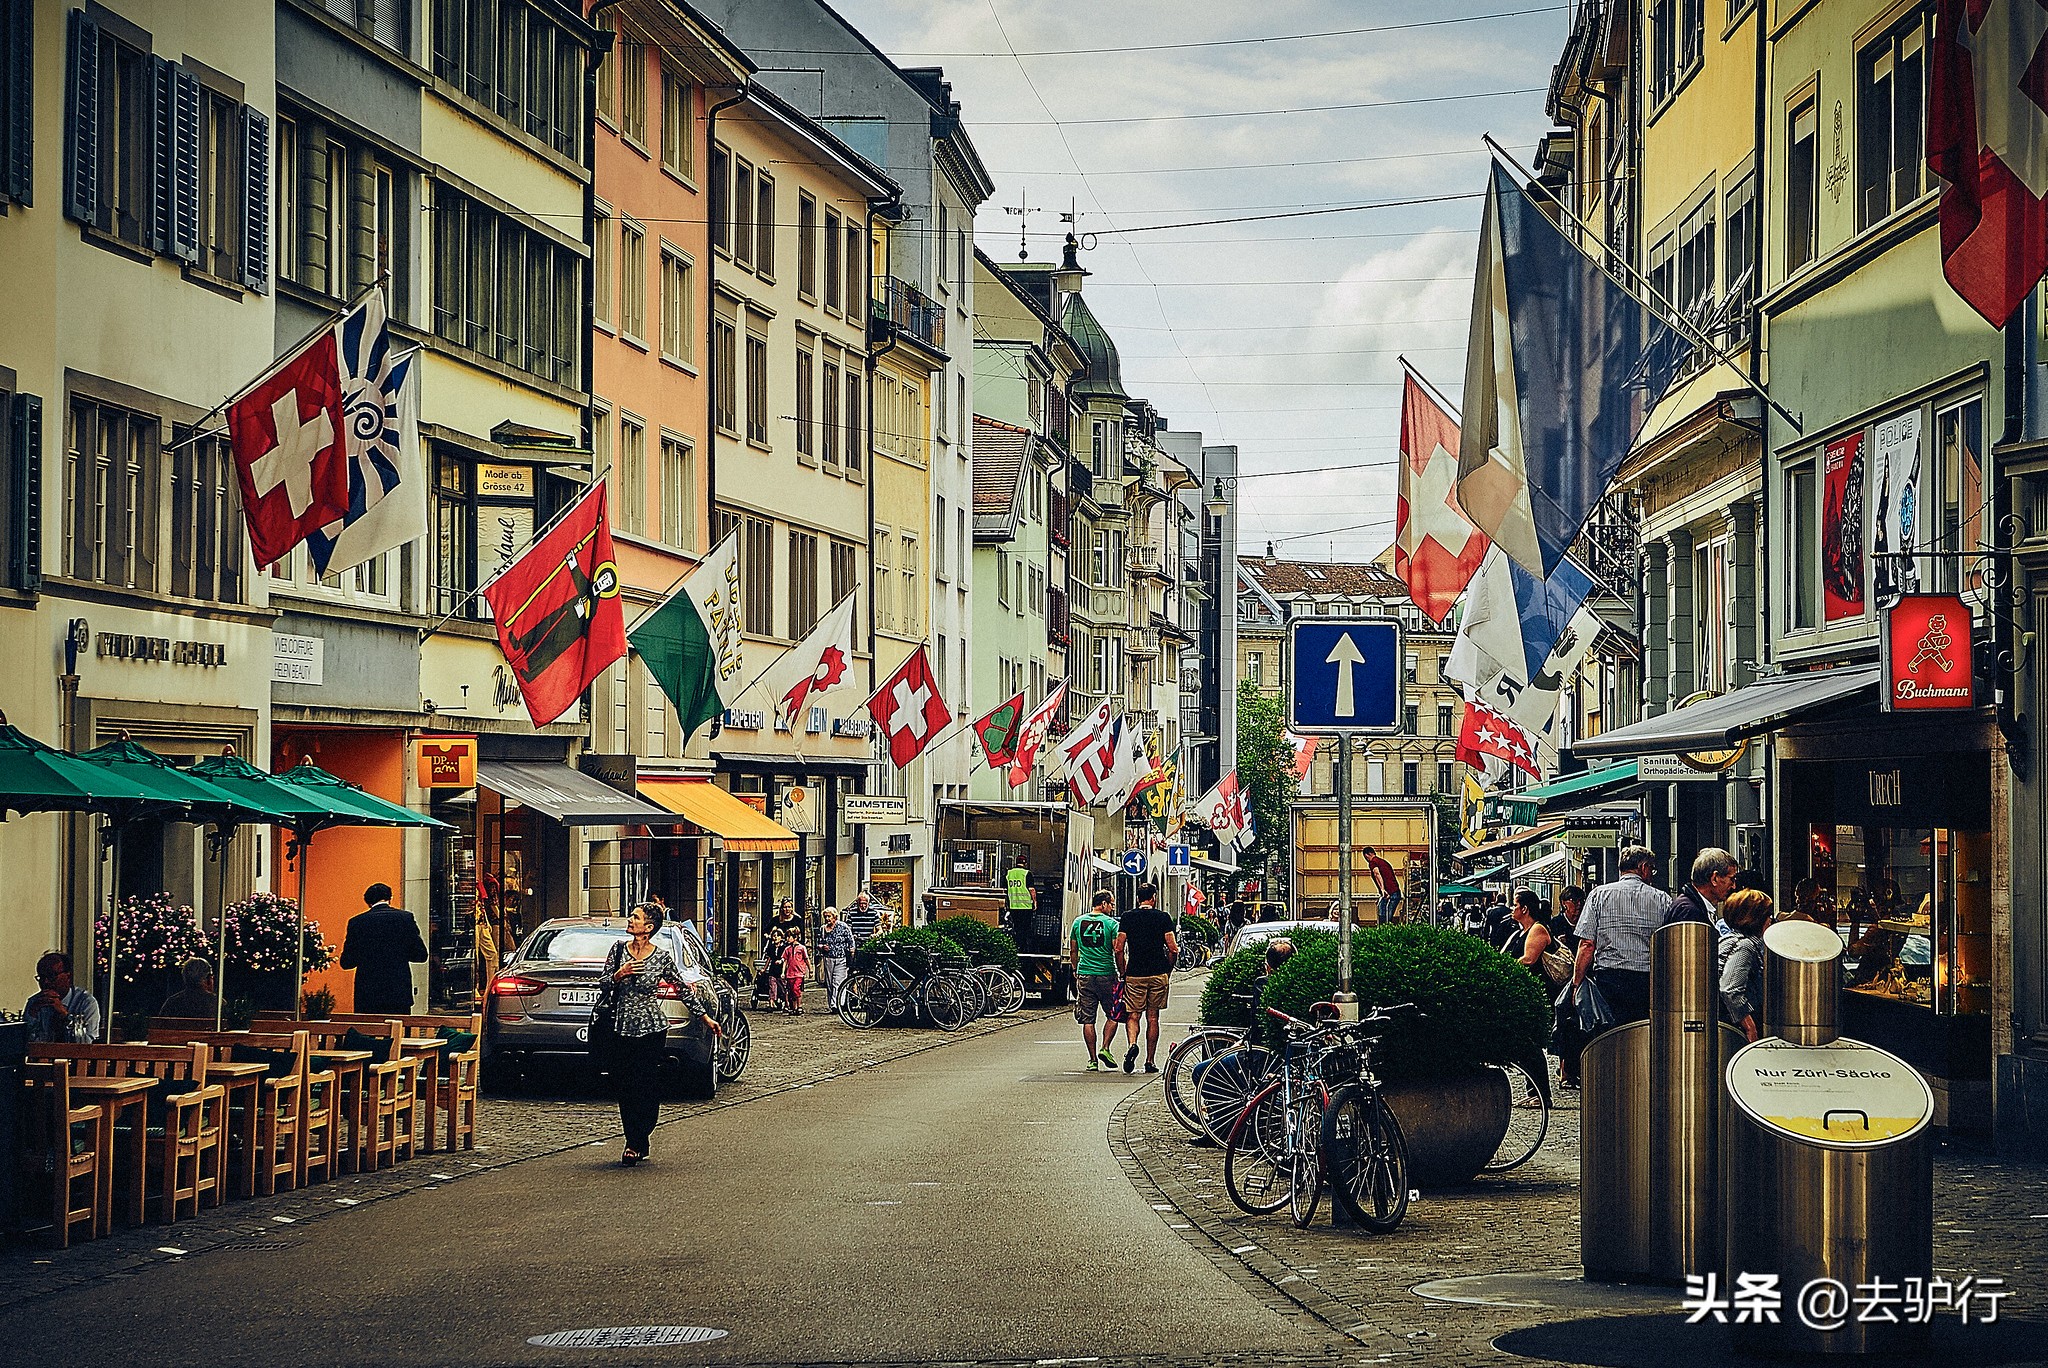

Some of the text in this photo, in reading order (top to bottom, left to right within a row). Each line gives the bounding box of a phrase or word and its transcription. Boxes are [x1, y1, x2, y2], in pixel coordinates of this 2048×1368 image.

[1880, 418, 1913, 450] POLICE
[484, 470, 522, 480] Mode ab
[482, 481, 525, 491] Grösse 42
[274, 637, 288, 652] YVES
[274, 662, 311, 679] HELEN BEAUTY
[1896, 679, 1969, 700] Buchmann
[1643, 757, 1682, 766] Sanitätsg
[433, 764, 457, 774] am
[1869, 770, 1901, 806] URECH
[847, 800, 904, 809] ZUMSTEIN
[1009, 879, 1022, 888] DPD
[1754, 1068, 1891, 1079] Nur Züri-Säcke
